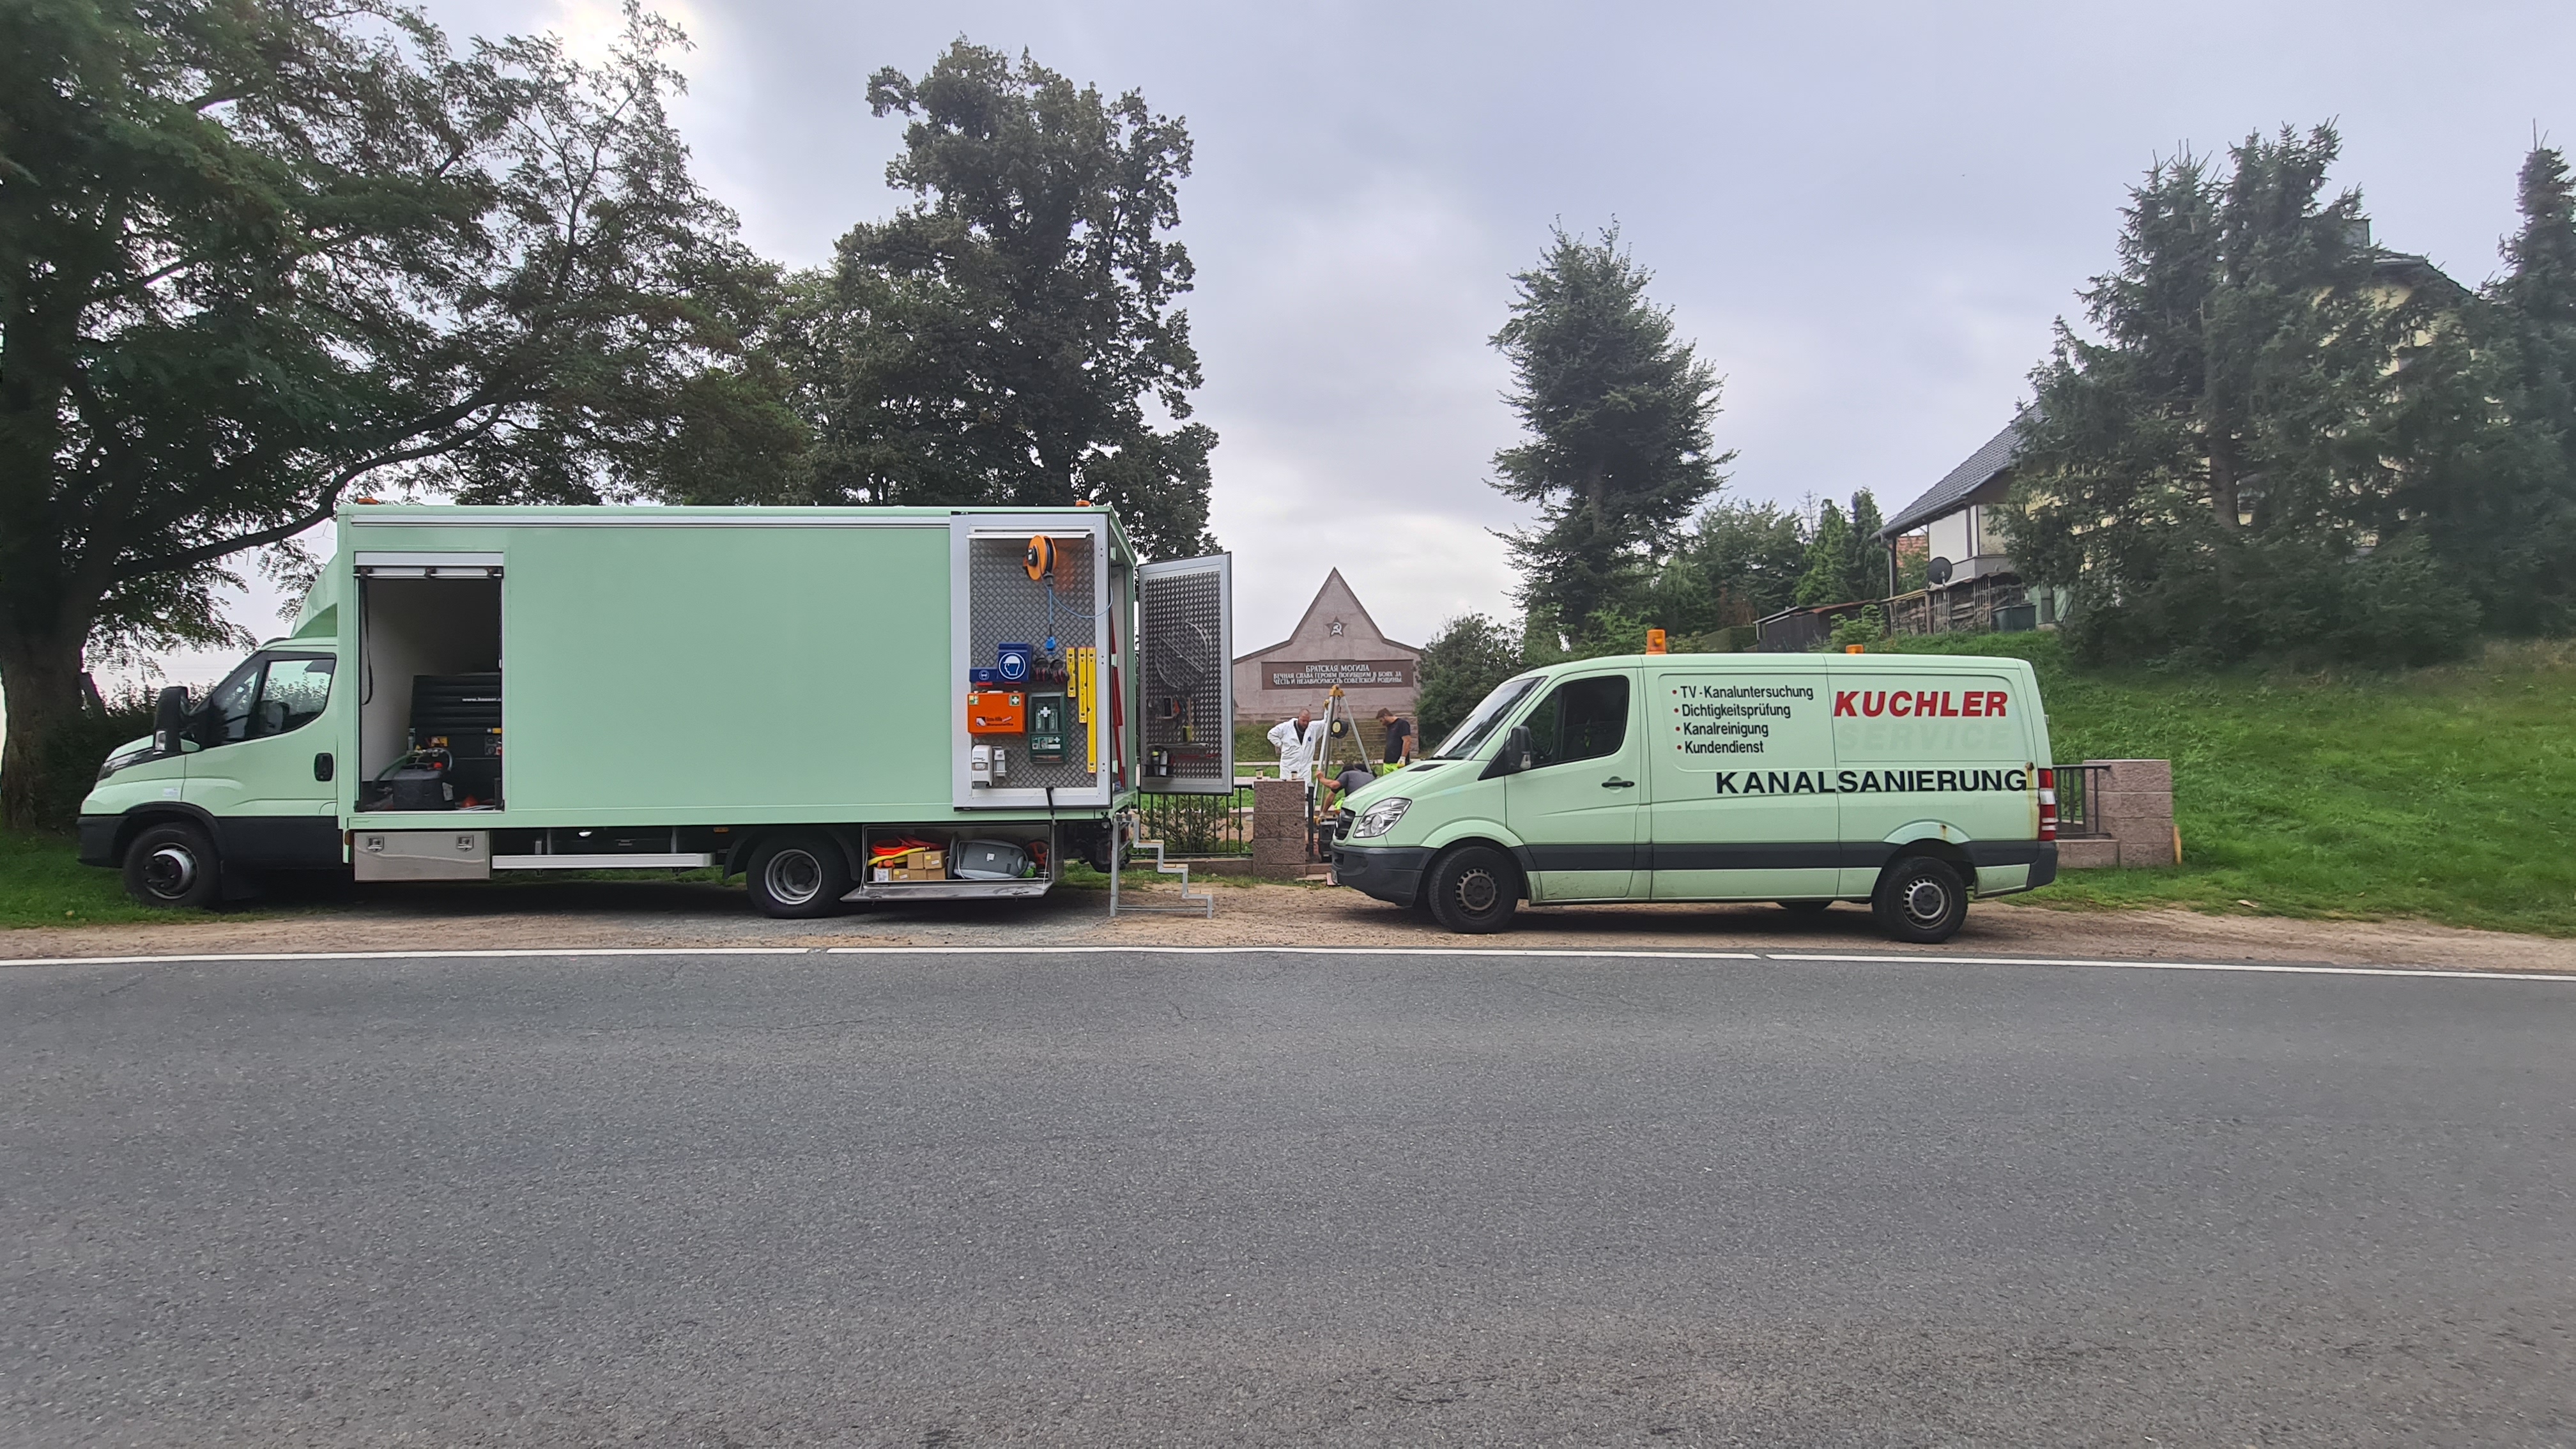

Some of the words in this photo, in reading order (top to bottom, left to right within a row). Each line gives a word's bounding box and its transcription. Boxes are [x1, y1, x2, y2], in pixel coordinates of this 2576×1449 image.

[1680, 685, 1814, 700] TV-Kanaluntersuchung
[1682, 703, 1791, 719] Dichtigkeitsprüfung
[1834, 691, 2008, 717] KUCHLER
[1683, 722, 1768, 737] Kanalreinigung
[1836, 723, 2012, 751] SERVICE
[1685, 740, 1764, 753] Kundendienst
[1716, 770, 2027, 793] KANALSANIERUNG
